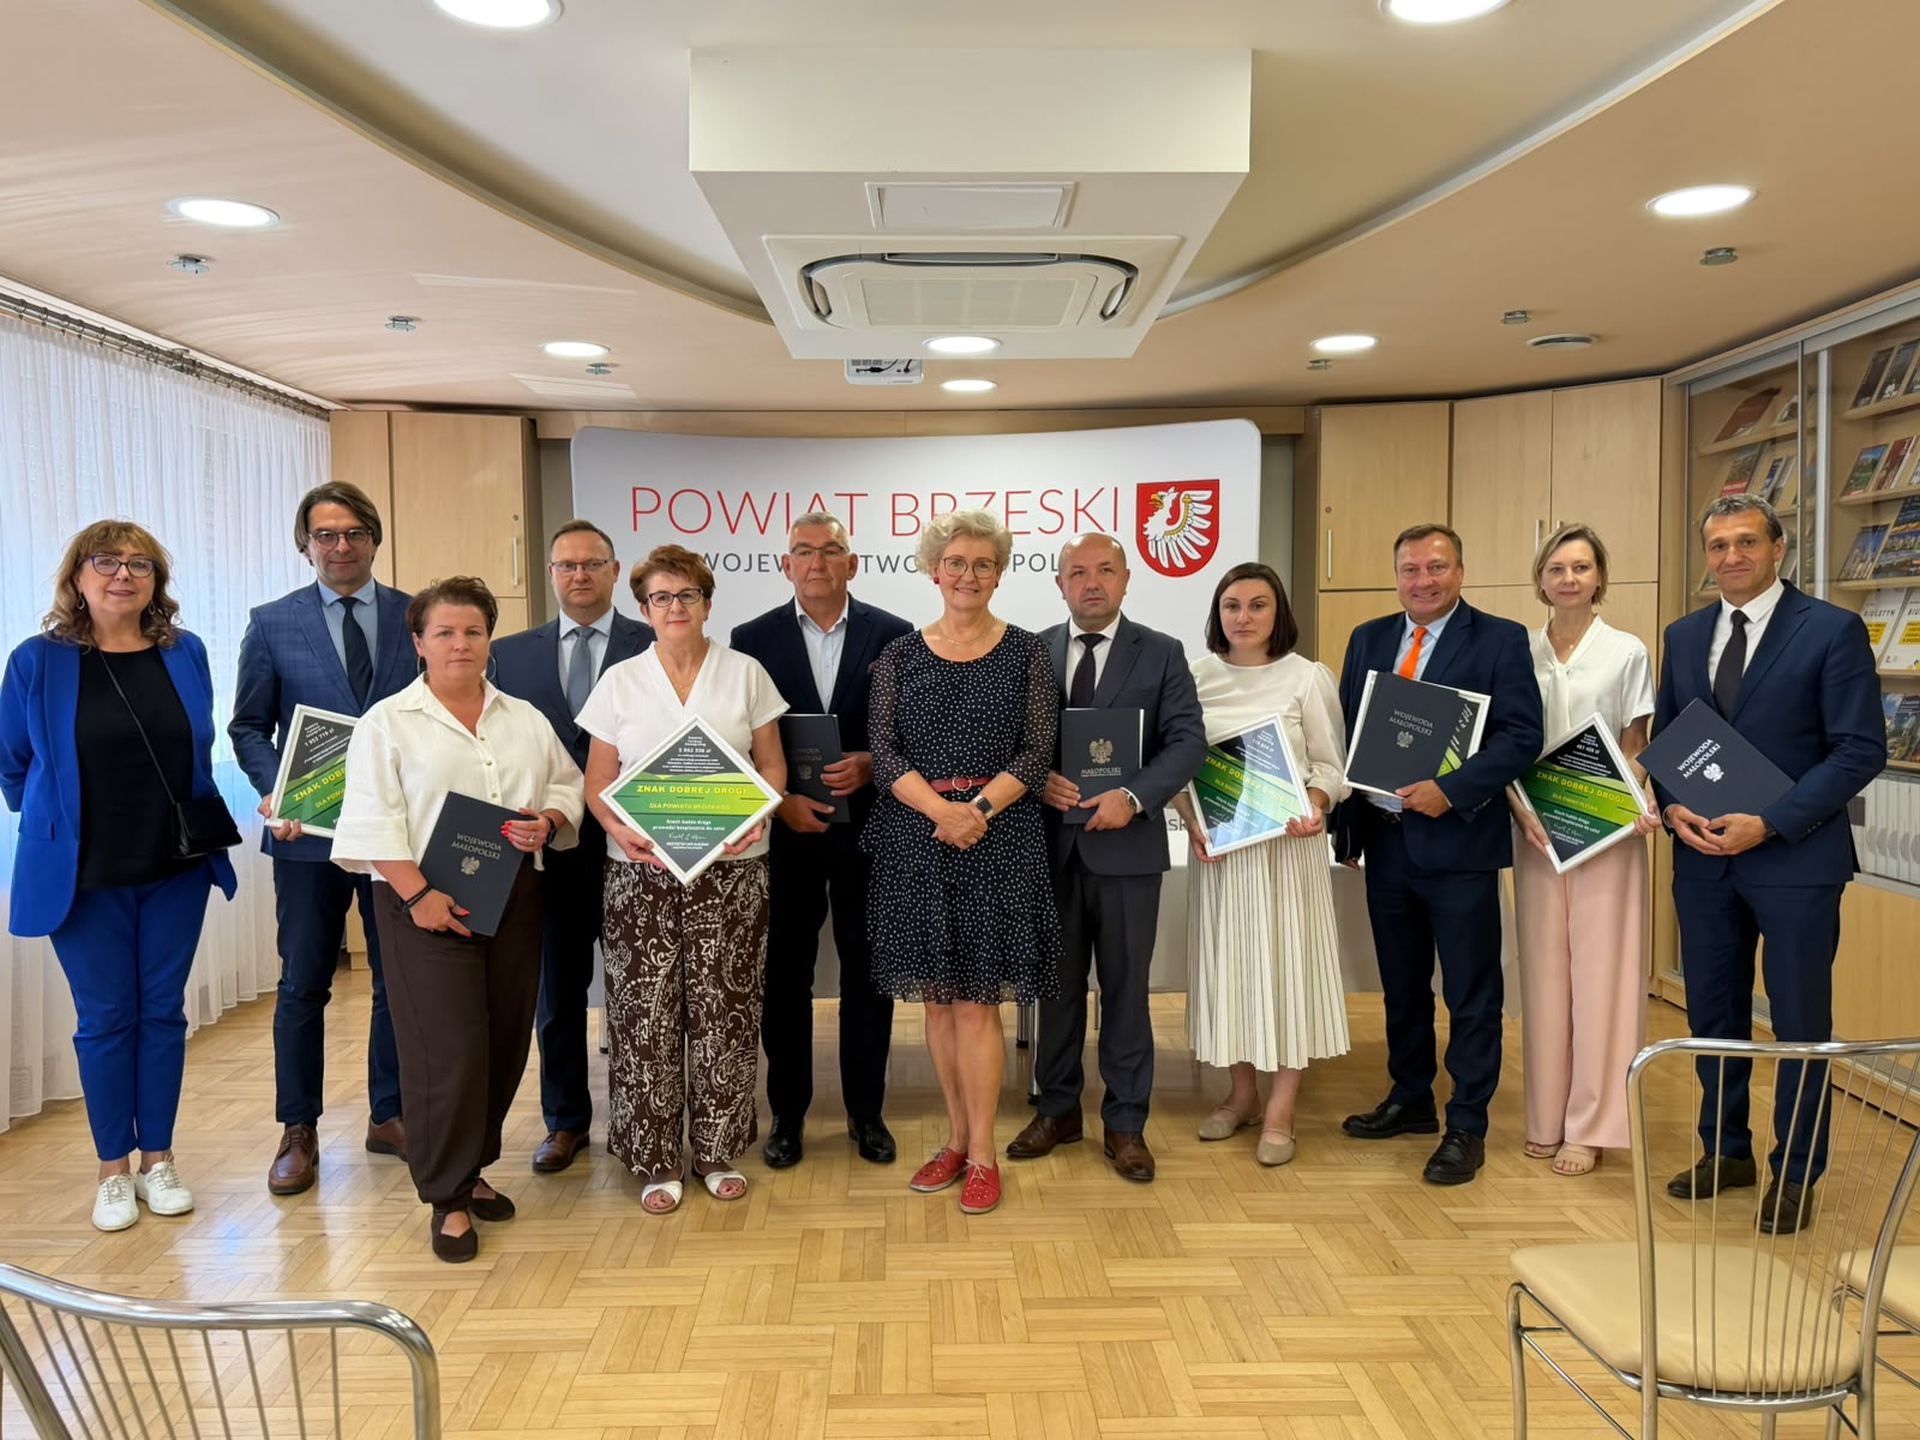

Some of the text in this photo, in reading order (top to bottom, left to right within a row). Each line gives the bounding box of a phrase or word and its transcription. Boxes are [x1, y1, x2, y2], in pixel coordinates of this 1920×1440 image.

[1393, 708, 1434, 729] WOJEWODA
[1205, 756, 1228, 772] ZNAK
[1677, 739, 1714, 771] WOJEWODA
[1683, 743, 1721, 779] MAŁOPOLSKI
[293, 767, 346, 801] ZNAK DOB
[637, 785, 746, 795] ZNAK DOBREJ DROGI
[1536, 771, 1625, 804] ZNAK DOBREJ DROGI
[456, 832, 502, 851] WOJEWODA
